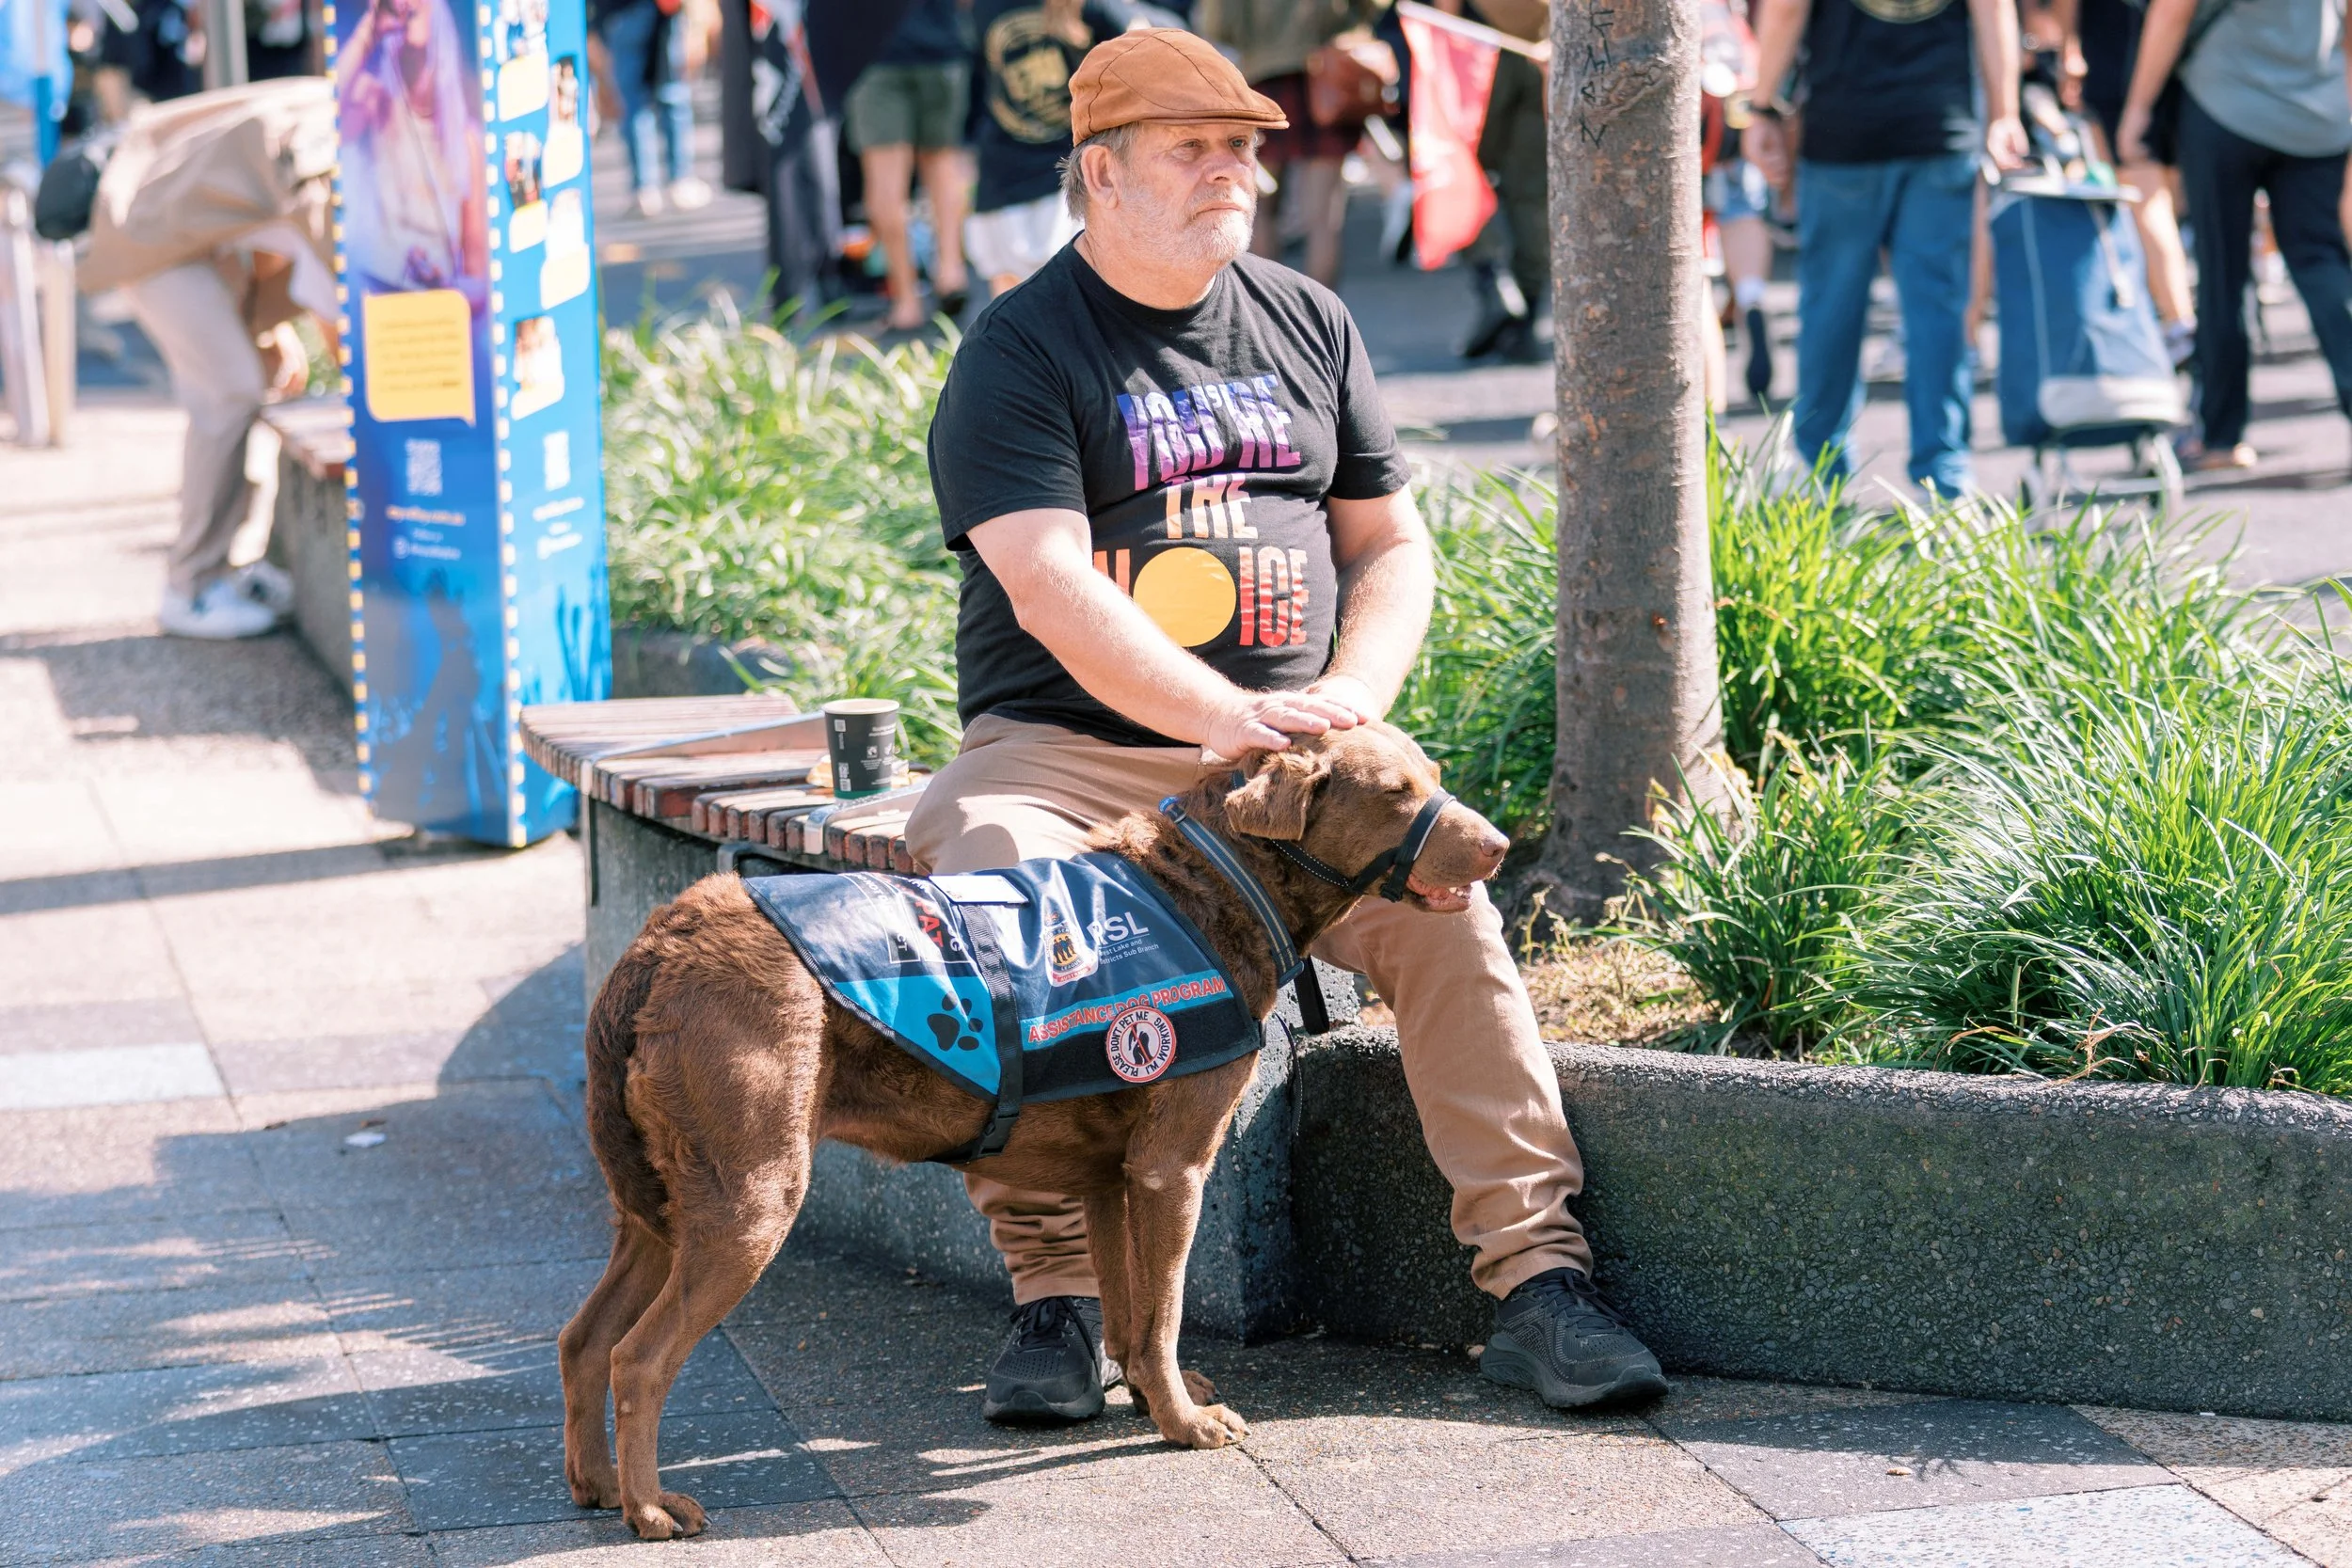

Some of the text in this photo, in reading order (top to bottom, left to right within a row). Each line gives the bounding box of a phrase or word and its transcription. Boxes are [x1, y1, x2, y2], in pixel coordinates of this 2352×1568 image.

[1164, 472, 1259, 539] THE
[915, 900, 944, 948] PAT
[1086, 911, 1149, 946] RSL
[1113, 942, 1130, 953] Lake
[1130, 938, 1143, 946] and
[1123, 948, 1137, 958] Sub
[1136, 942, 1160, 955] Branch
[1027, 1005, 1116, 1043] ASSISTANCE
[1152, 975, 1227, 1008] PROGRAM
[1119, 1013, 1135, 1029] PET
[1136, 1011, 1149, 1021] ME
[1153, 1017, 1171, 1062] WORKING
[1112, 1053, 1139, 1077] PLEASE
